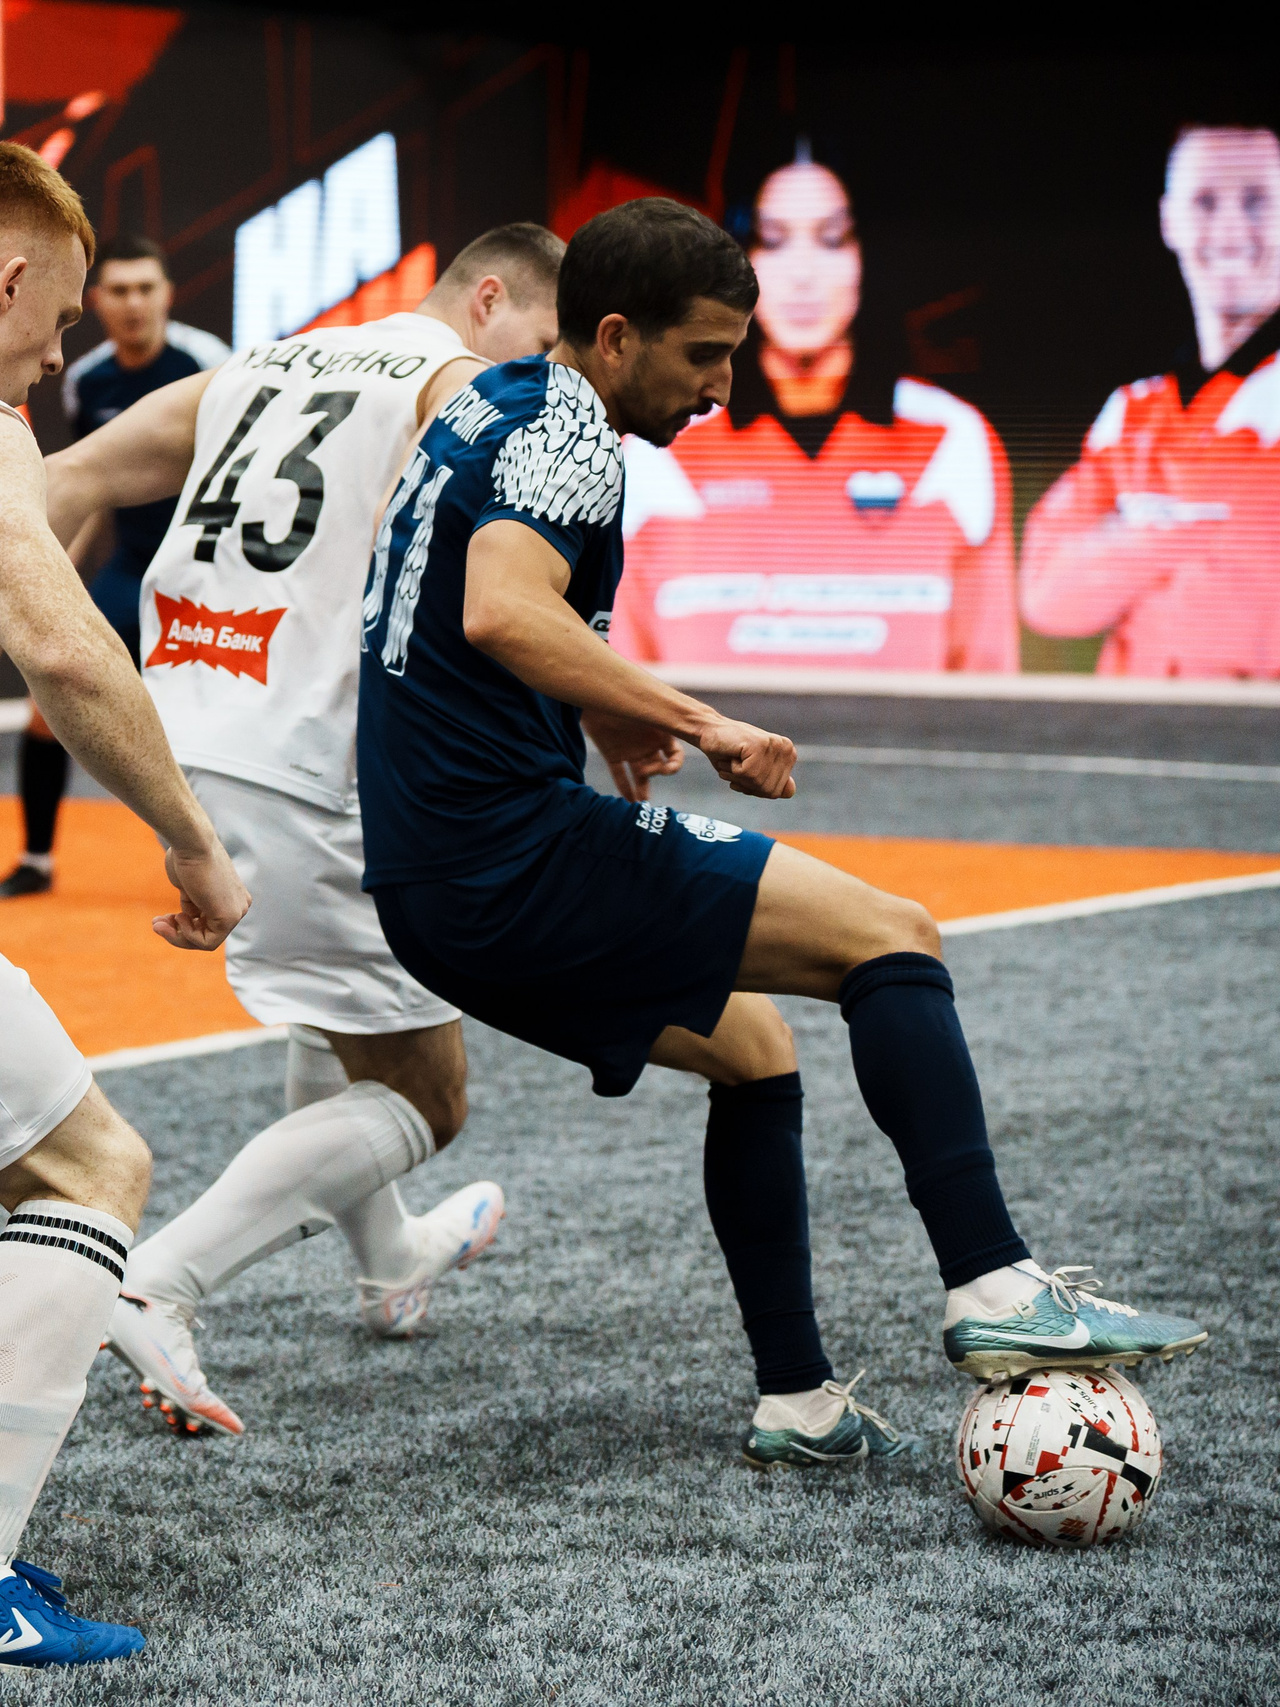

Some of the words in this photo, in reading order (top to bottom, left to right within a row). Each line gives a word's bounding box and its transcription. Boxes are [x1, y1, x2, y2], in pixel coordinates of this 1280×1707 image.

[232, 131, 401, 350] НА
[181, 386, 361, 573] 43
[166, 618, 215, 650] Альфа
[216, 626, 264, 653] Банк
